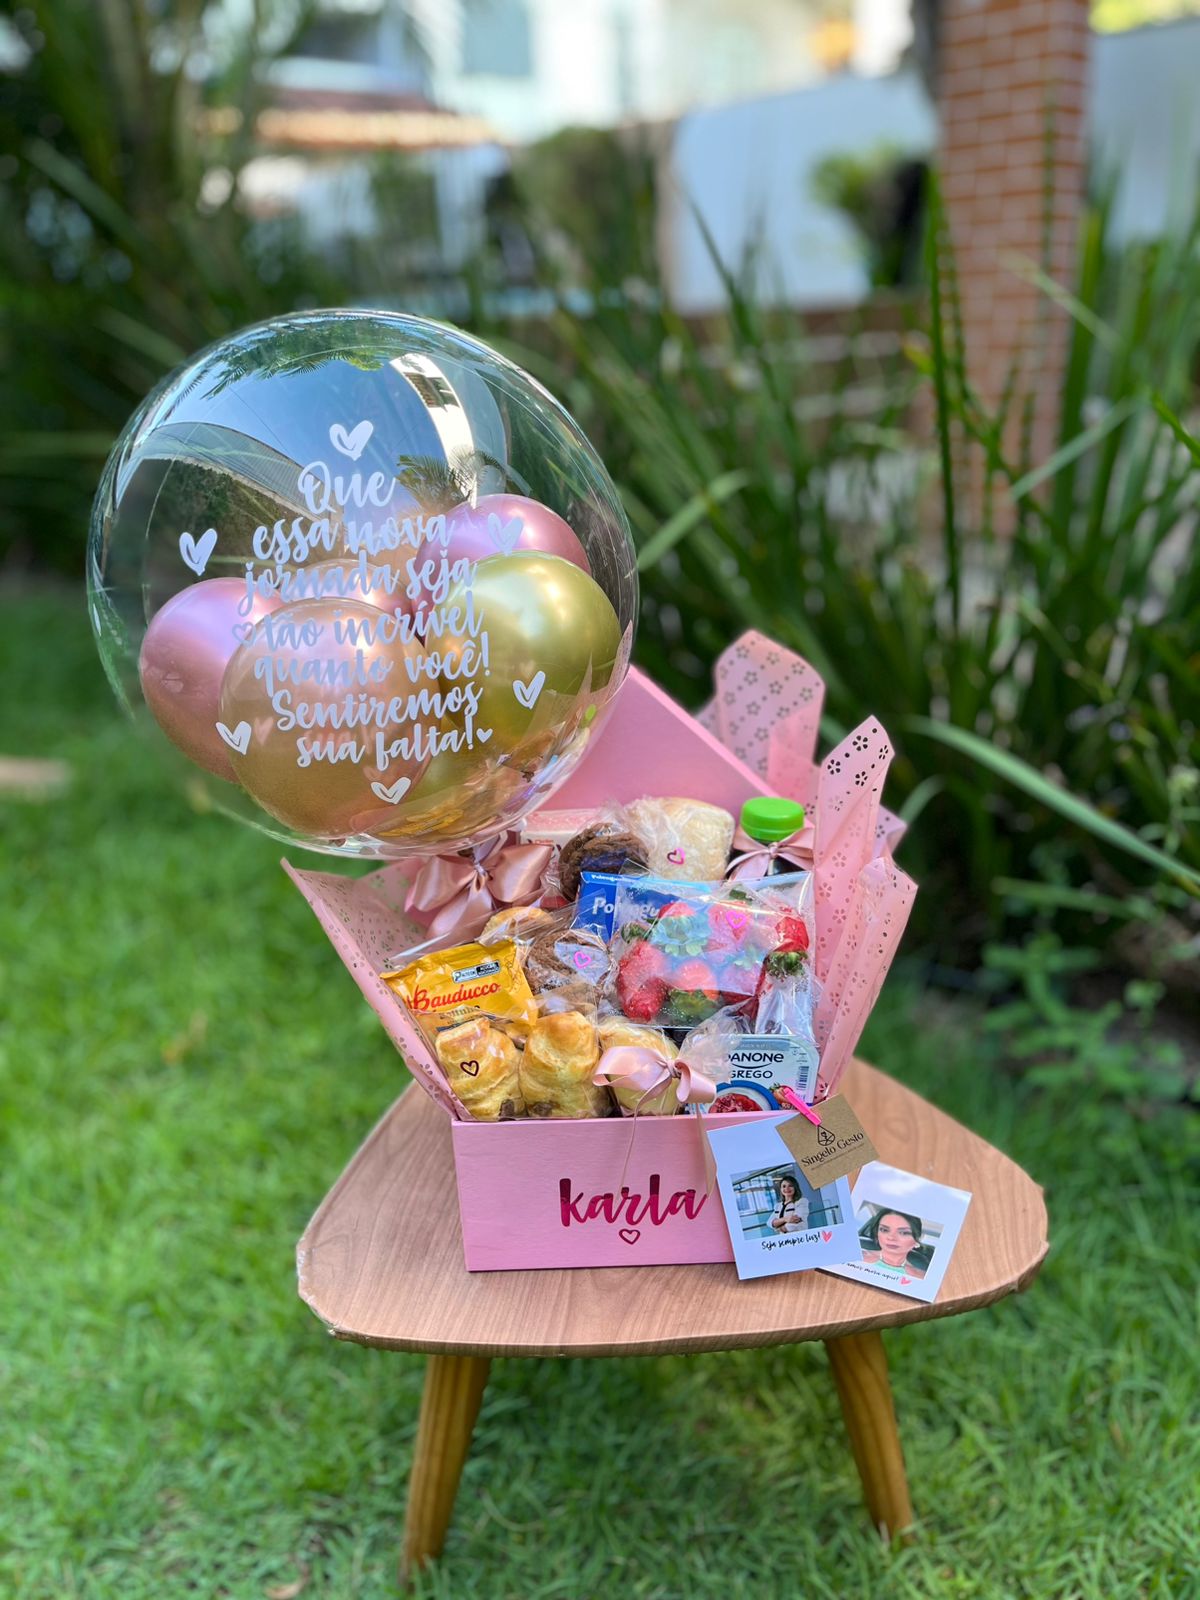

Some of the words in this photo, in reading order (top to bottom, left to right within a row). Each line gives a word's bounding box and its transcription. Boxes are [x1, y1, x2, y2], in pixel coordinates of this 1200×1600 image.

[298, 461, 397, 514] Que
[253, 516, 339, 565] essa
[344, 513, 455, 557] nova
[237, 550, 400, 617] jornada
[406, 549, 478, 605] seja
[263, 611, 325, 651] tão
[333, 590, 487, 647] incrível
[254, 648, 394, 698] quanto
[404, 631, 491, 683] você!
[272, 681, 483, 731] Sentiremos
[296, 736, 366, 768] sua
[375, 714, 473, 772] falta!
[407, 982, 501, 1012] Bauducco
[801, 1146, 837, 1167] Singelo
[836, 1132, 864, 1150] Gesto
[559, 1173, 708, 1227] karla
[761, 1240, 776, 1251] Seja
[778, 1236, 804, 1248] sempre
